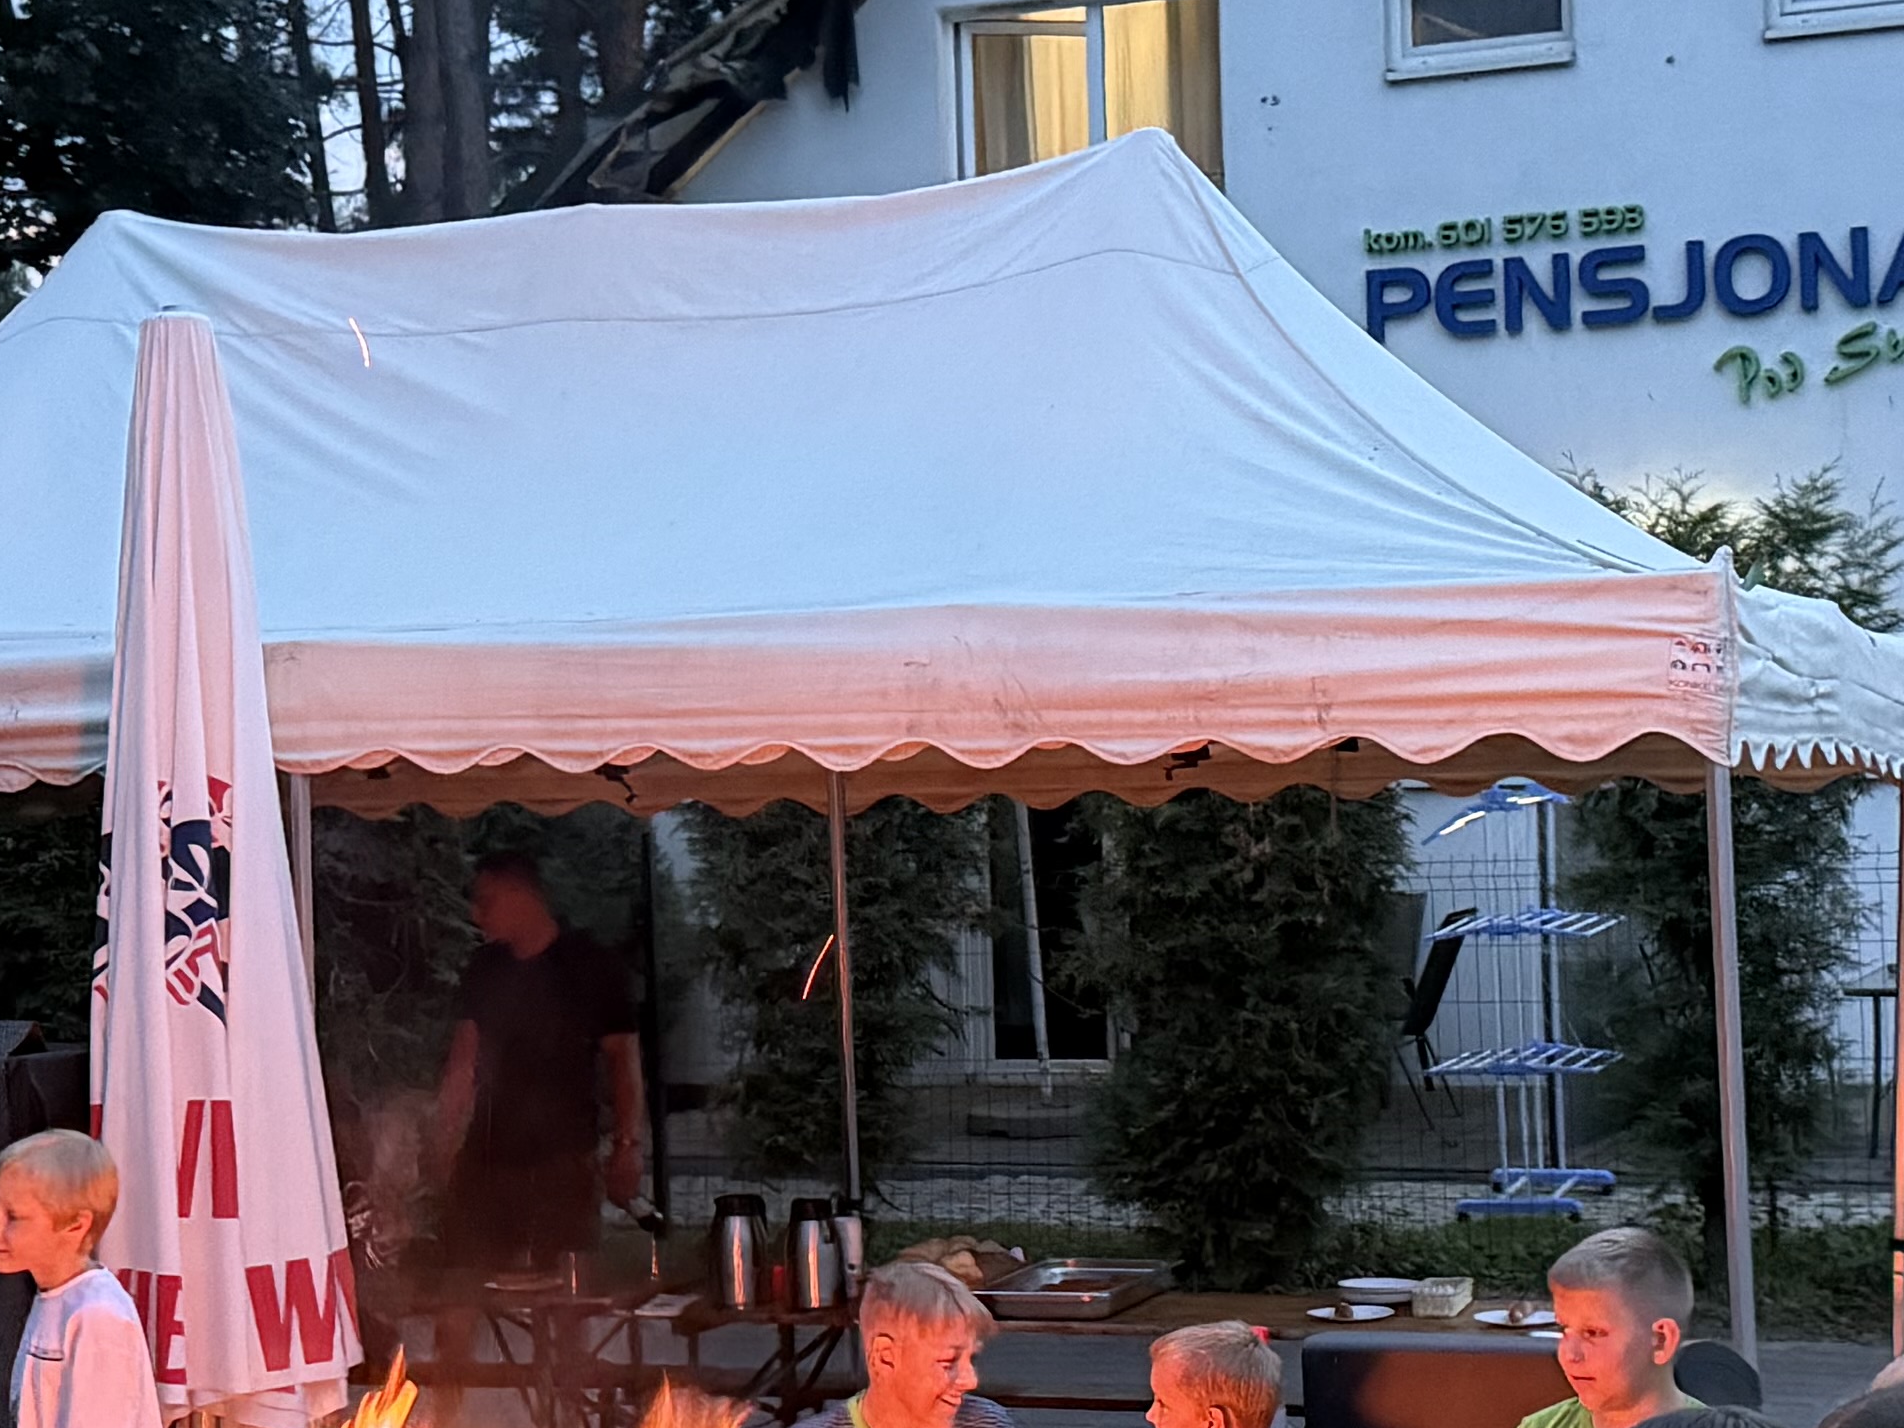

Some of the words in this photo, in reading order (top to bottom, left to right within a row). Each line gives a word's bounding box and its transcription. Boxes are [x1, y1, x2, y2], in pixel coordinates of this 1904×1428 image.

[1438, 217, 1492, 247] 601
[1503, 210, 1569, 243] 576
[1713, 345, 1805, 405] Pod
